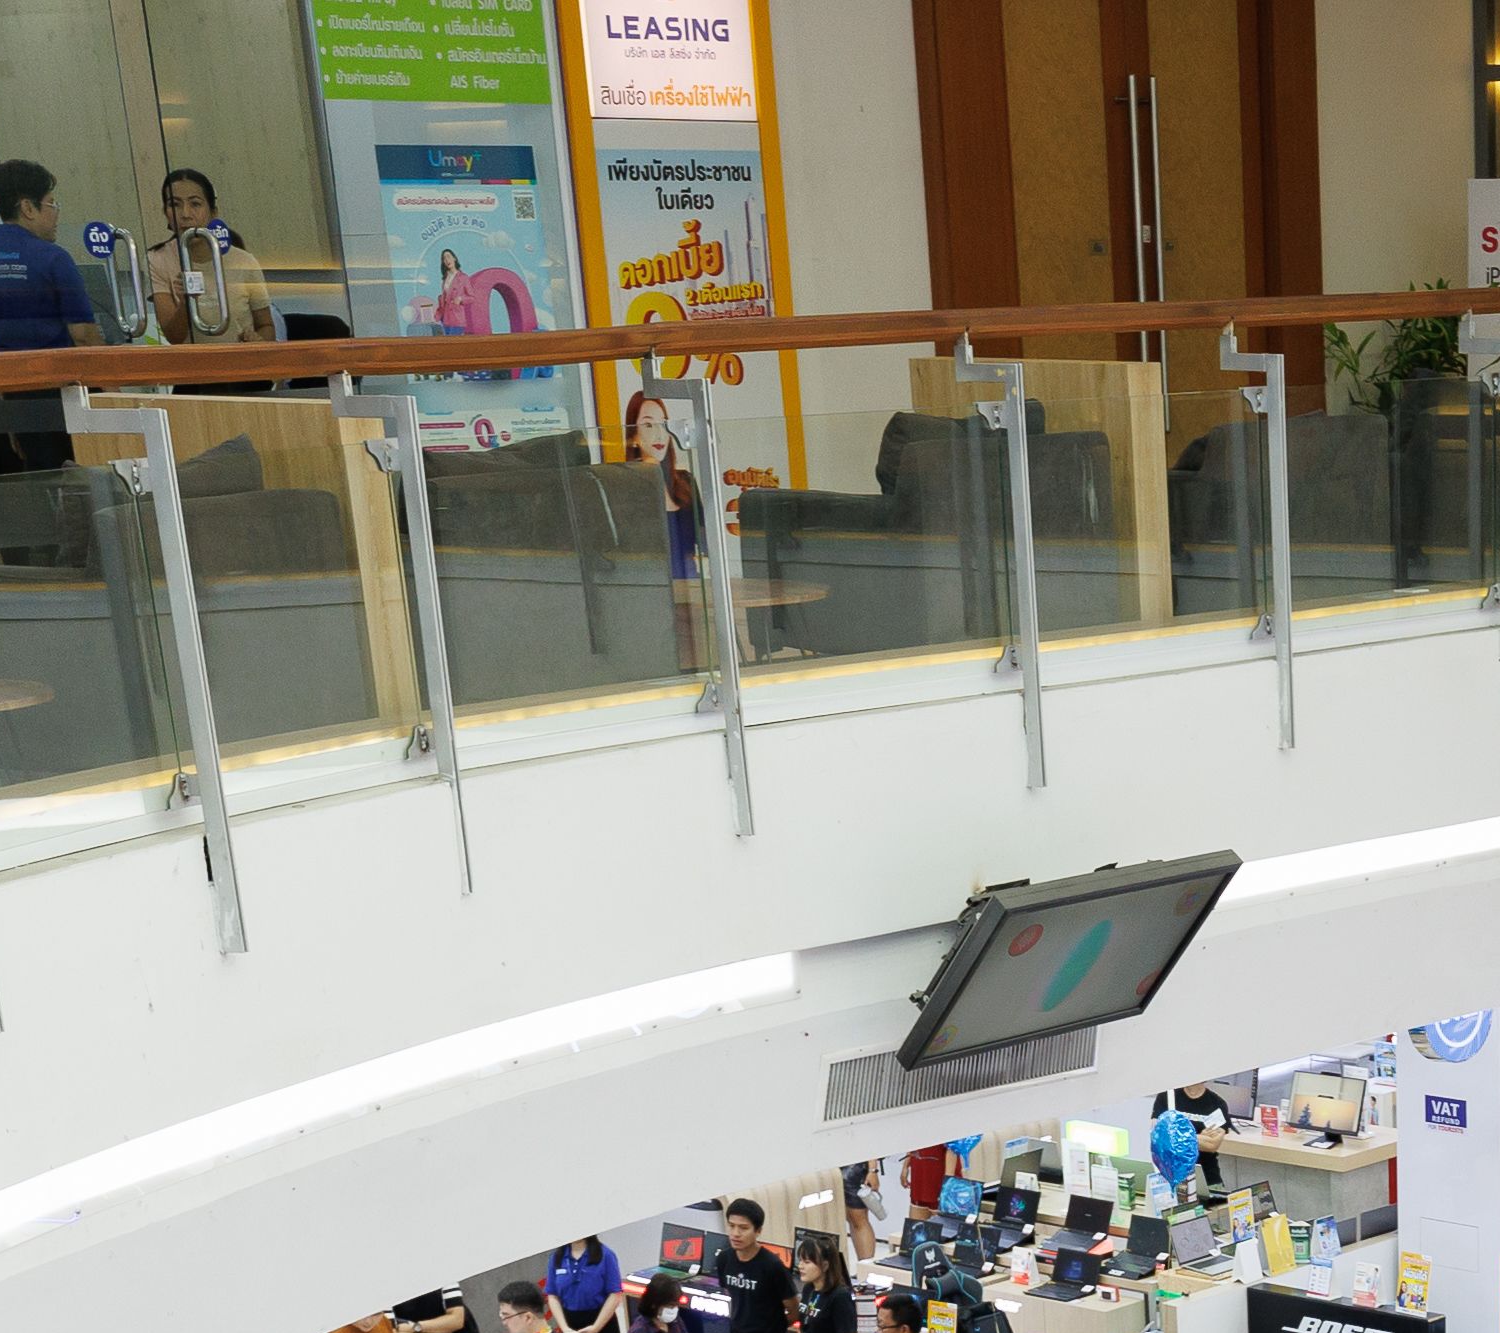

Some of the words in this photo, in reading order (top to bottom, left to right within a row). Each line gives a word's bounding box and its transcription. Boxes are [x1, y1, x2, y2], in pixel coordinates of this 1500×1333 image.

[606, 15, 730, 42] LEASING
[450, 77, 467, 88] AIS
[474, 76, 500, 90] Fiber
[601, 80, 647, 107] สินเชื่อ
[649, 78, 751, 107] เครื่องใช้ไฟฟ้า
[607, 159, 751, 182] เพียงบัตรประชาชน
[656, 187, 714, 211] ใบเดียว
[89, 227, 108, 243] ดึง
[92, 246, 110, 254] PULL
[618, 219, 725, 289] ดอกเบี้ย
[1429, 1099, 1461, 1117] VAT
[1429, 1114, 1461, 1127] REFUND
[726, 1274, 758, 1291] TRUST
